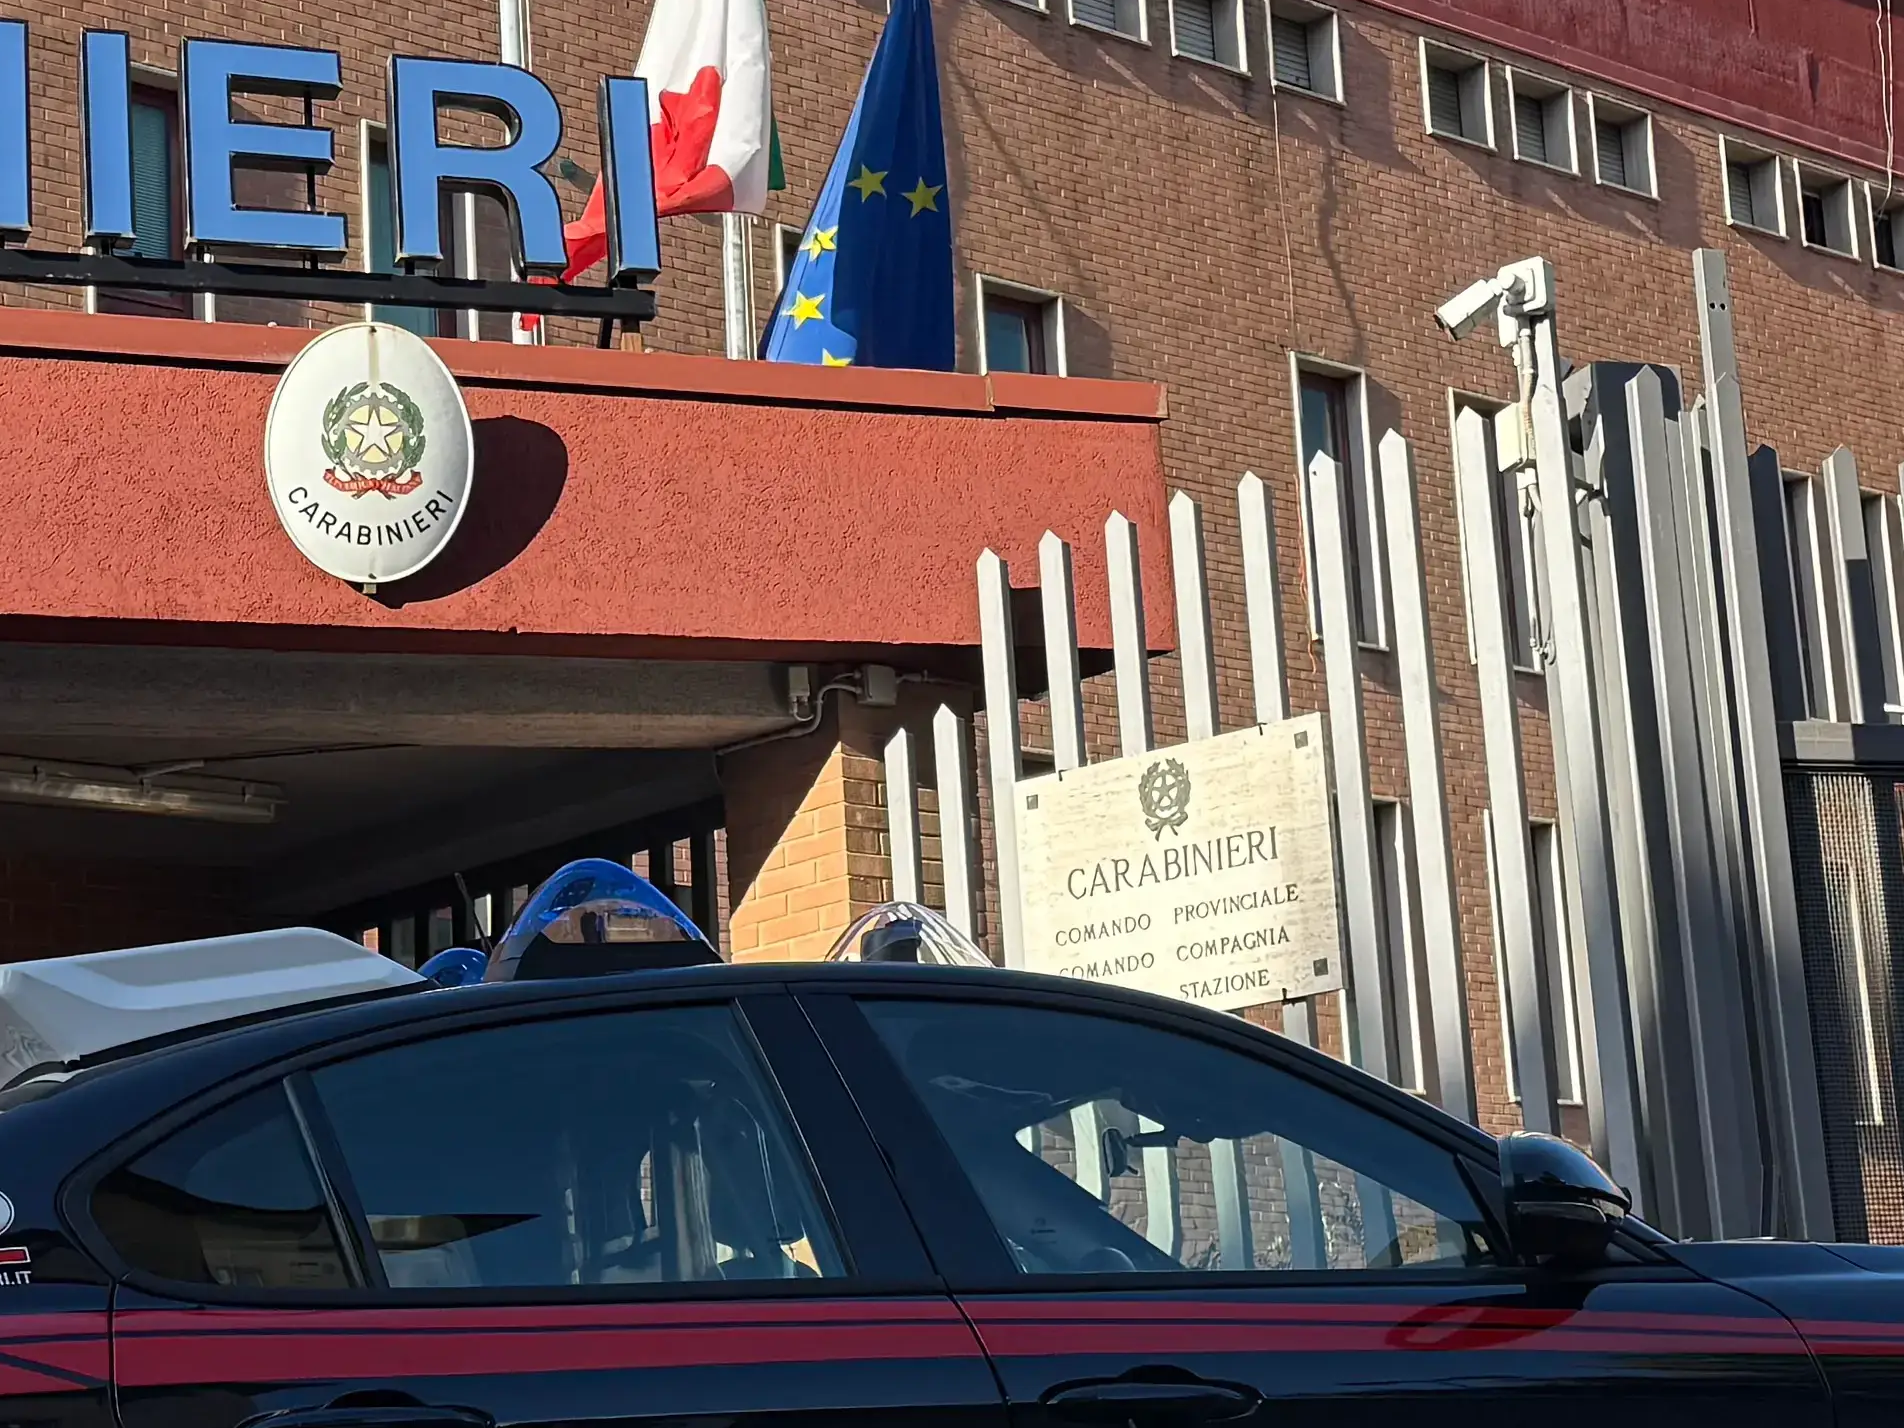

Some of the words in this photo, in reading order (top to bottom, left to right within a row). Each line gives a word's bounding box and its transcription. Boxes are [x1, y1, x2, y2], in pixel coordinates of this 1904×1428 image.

[287, 486, 455, 546] CARABINIERI
[1066, 825, 1281, 901] CARABINIERI
[1055, 913, 1151, 947] COMANDO
[1173, 883, 1300, 925] PROVINCIALE
[1175, 925, 1291, 962] COMPAGNIA
[1179, 969, 1271, 1000] STAZIONE
